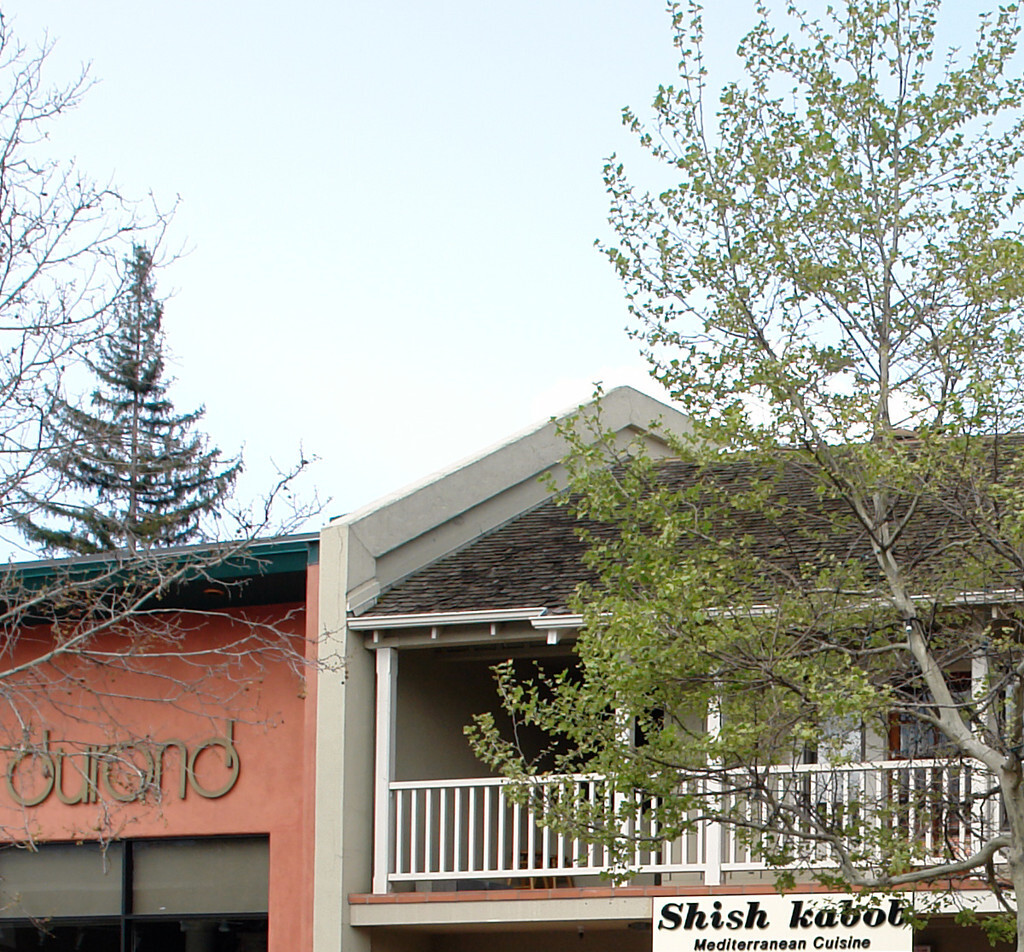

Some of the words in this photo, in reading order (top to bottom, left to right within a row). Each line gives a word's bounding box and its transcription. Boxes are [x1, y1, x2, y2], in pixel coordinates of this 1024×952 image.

[658, 901, 770, 930] Shish
[694, 938, 807, 952] Mediterranean
[813, 936, 871, 950] Cuisine
